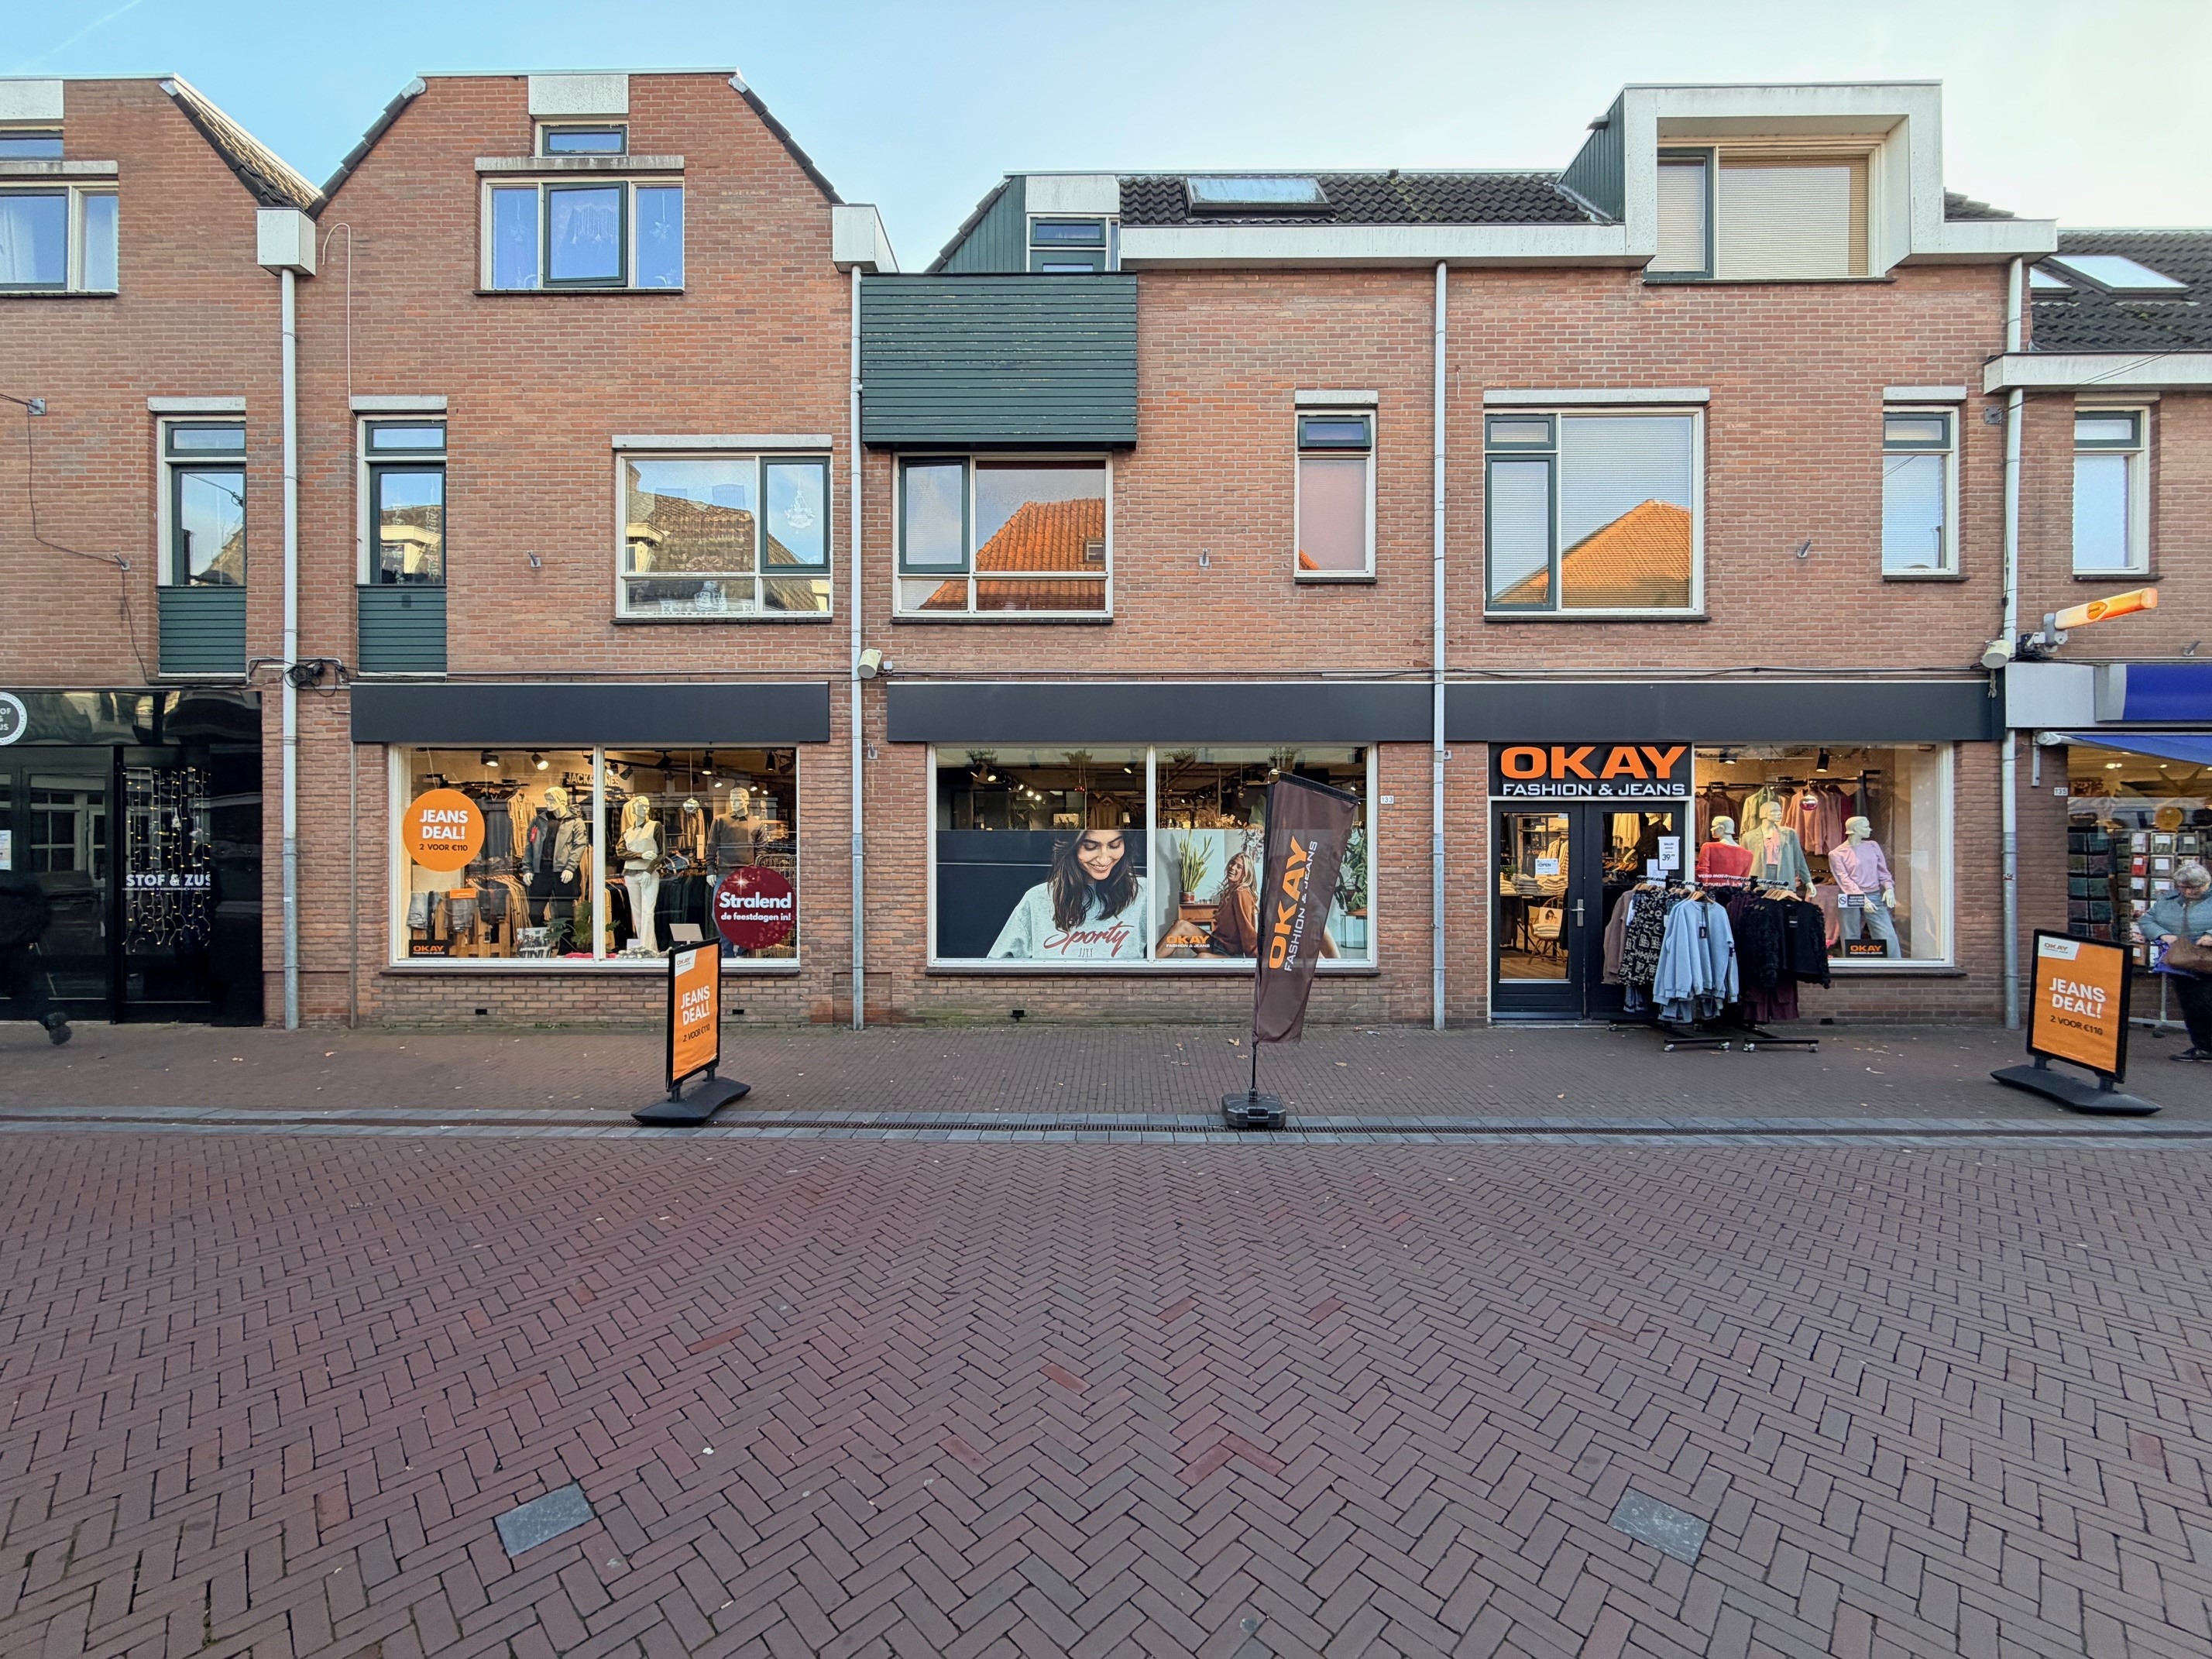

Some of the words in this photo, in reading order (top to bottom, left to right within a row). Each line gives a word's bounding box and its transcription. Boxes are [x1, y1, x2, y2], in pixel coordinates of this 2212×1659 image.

[1501, 746, 1687, 779] OKAY
[1503, 783, 1592, 795] FASHION
[1599, 783, 1613, 795] &
[1618, 783, 1685, 795] JEANS
[420, 809, 469, 823] JEANS
[422, 826, 465, 840] DEAL!
[126, 874, 165, 886] STOF
[170, 874, 180, 886] &
[719, 891, 792, 908] Stralend
[1269, 835, 1307, 969] OKAY
[1284, 908, 1306, 971] FASHION
[1301, 893, 1307, 904] &
[1304, 840, 1318, 890] JEANS
[721, 912, 732, 920] de
[733, 912, 779, 922] feestdagen
[781, 912, 791, 921] in!
[1043, 921, 1135, 958] Sporty
[1166, 935, 1210, 944] OKAY
[2044, 943, 2069, 952] OKAY
[681, 985, 710, 1009] JEANS
[2049, 977, 2106, 1003] JEANS
[682, 1001, 710, 1025] DEAL!
[2052, 993, 2102, 1019] DEAL!
[688, 1028, 701, 1039] VOOR
[2058, 1017, 2083, 1030] VOOR
[2083, 1024, 2103, 1036] €110
